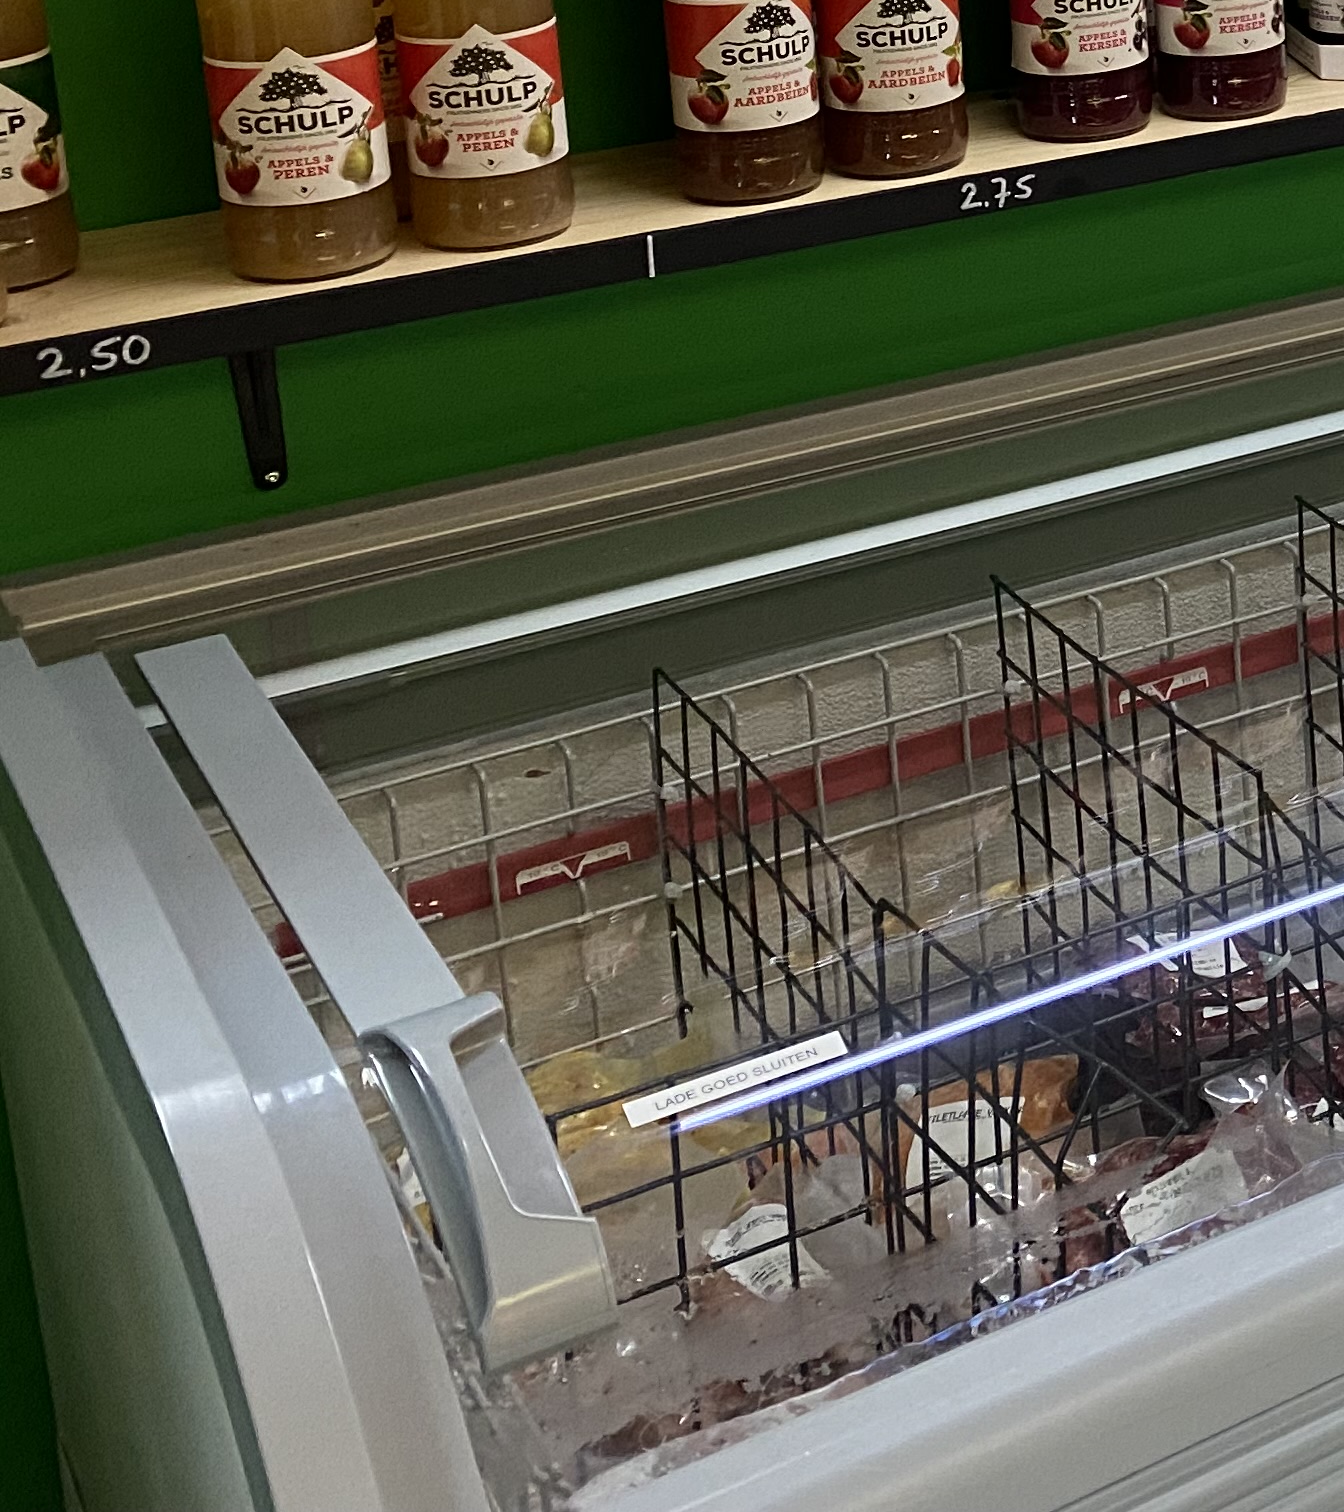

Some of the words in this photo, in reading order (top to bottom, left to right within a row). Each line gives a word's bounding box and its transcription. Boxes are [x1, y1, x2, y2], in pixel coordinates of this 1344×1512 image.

[1219, 16, 1257, 26] APPELS
[1219, 20, 1267, 35] KERSEN
[856, 22, 949, 48] SCHULP
[1078, 31, 1117, 43] APPELS
[720, 34, 811, 67] SCHULP
[1078, 37, 1128, 53] KERSEN
[867, 71, 947, 90] AARDBEIEN
[880, 68, 922, 80] APPELS
[428, 80, 538, 110] SCHULP
[748, 82, 788, 96] APPELS
[733, 87, 813, 109] AARDBEIEN
[237, 104, 355, 135] SCHULP
[456, 130, 507, 143] APPELS
[461, 138, 516, 153] PEREN
[266, 156, 324, 169] APPELS
[273, 164, 330, 181] PEREN
[654, 1089, 698, 1111] LADE
[700, 1071, 749, 1095] GOED
[752, 1046, 819, 1078] SLUITEN
